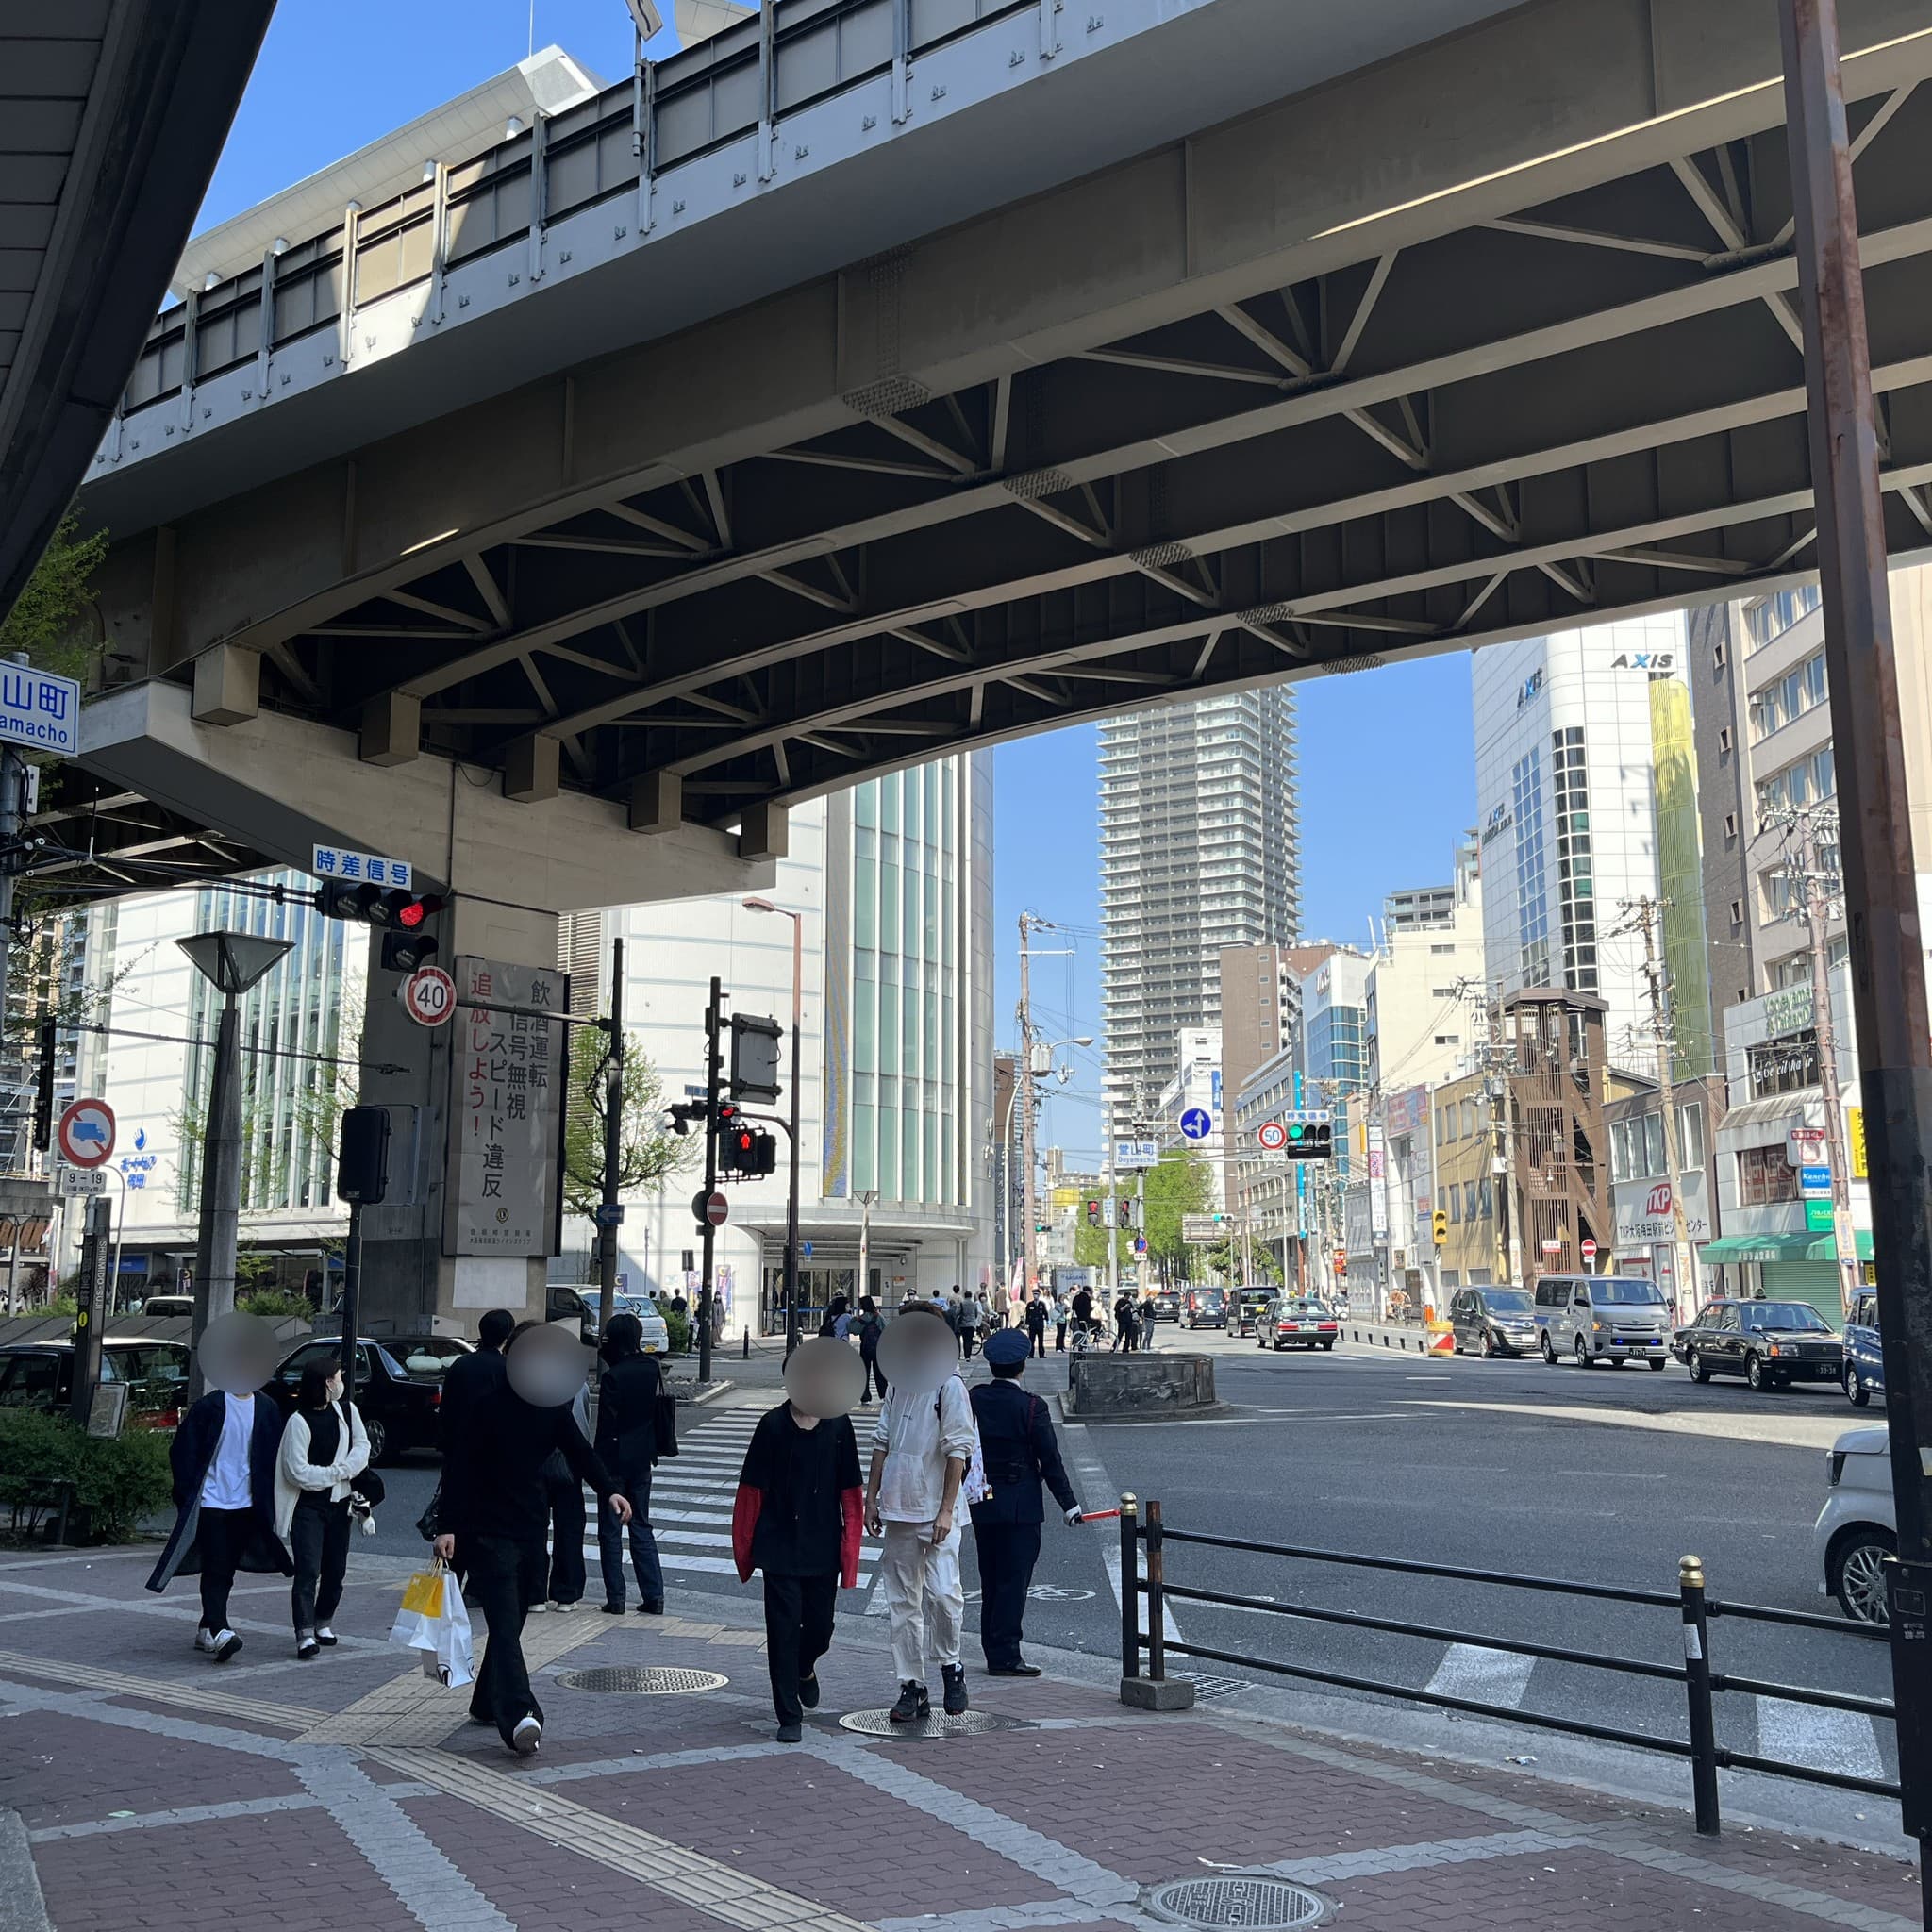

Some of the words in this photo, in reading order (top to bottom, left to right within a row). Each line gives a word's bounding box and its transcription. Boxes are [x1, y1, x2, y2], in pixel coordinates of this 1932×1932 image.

[1610, 653, 1674, 669] AXIS
[3, 675, 69, 720] 山町
[1517, 668, 1543, 708] AXIS
[316, 849, 408, 886] 時差信号
[416, 983, 444, 1008] 40
[528, 980, 551, 1088] 飲酒運転
[506, 1004, 529, 1120] 信号無視
[481, 1032, 508, 1199] スピード違反
[1264, 1130, 1280, 1142] 50
[1647, 1187, 1671, 1211] TKP
